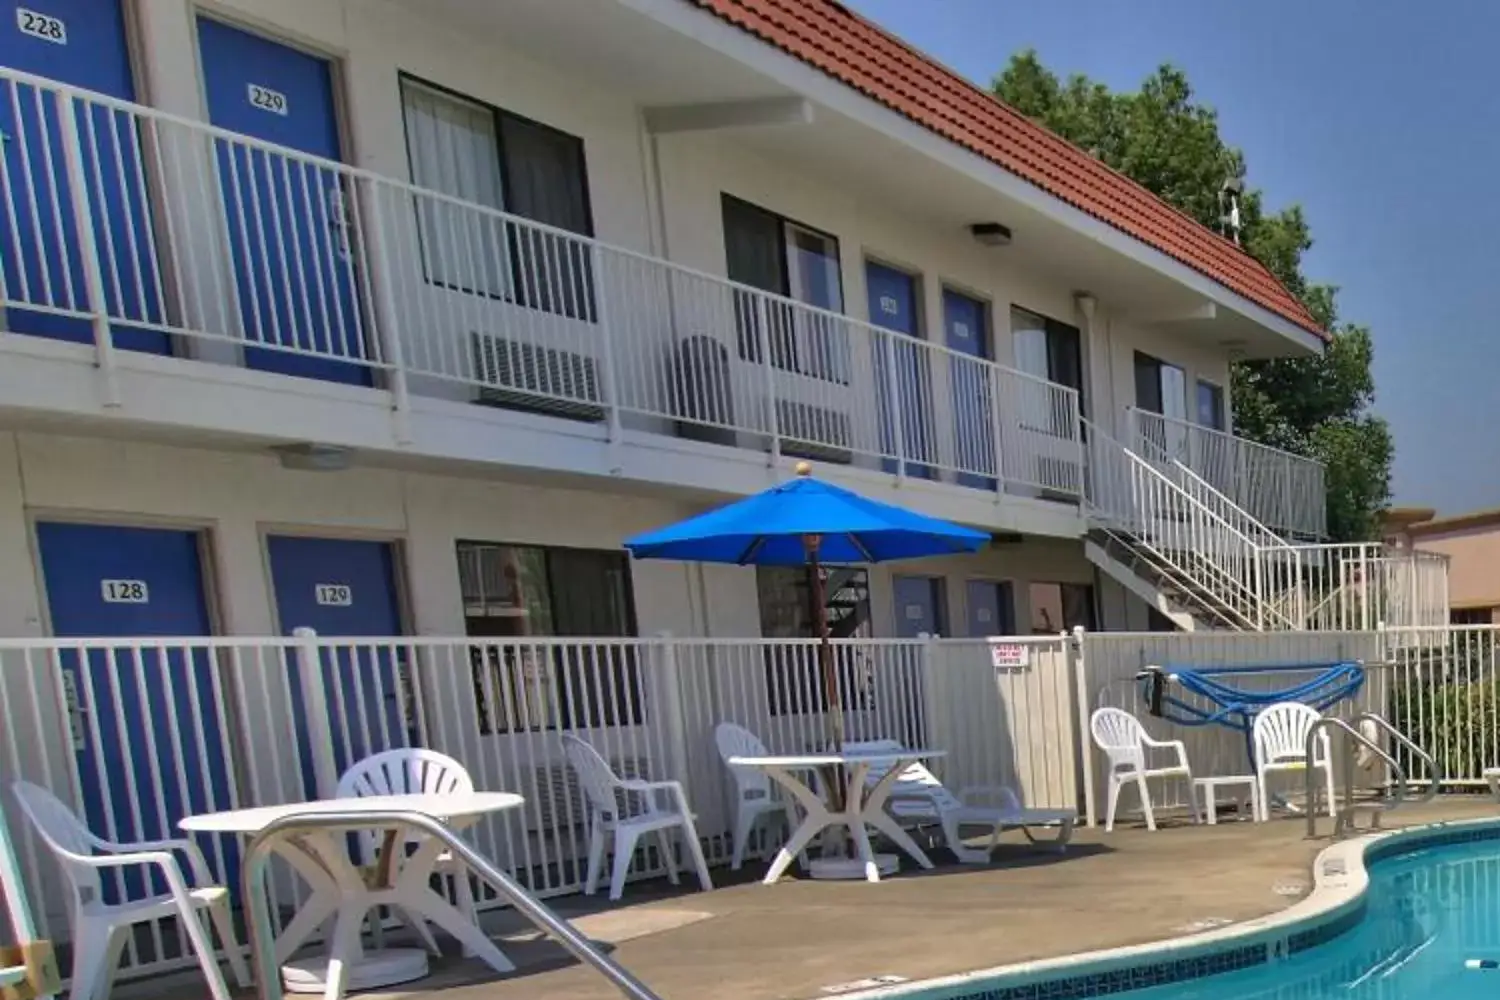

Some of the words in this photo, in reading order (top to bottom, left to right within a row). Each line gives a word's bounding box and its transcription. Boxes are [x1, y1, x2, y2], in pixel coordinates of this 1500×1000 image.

[23, 12, 63, 39] 228
[252, 87, 283, 110] 229
[108, 582, 143, 599] 128
[320, 587, 348, 602] 129
